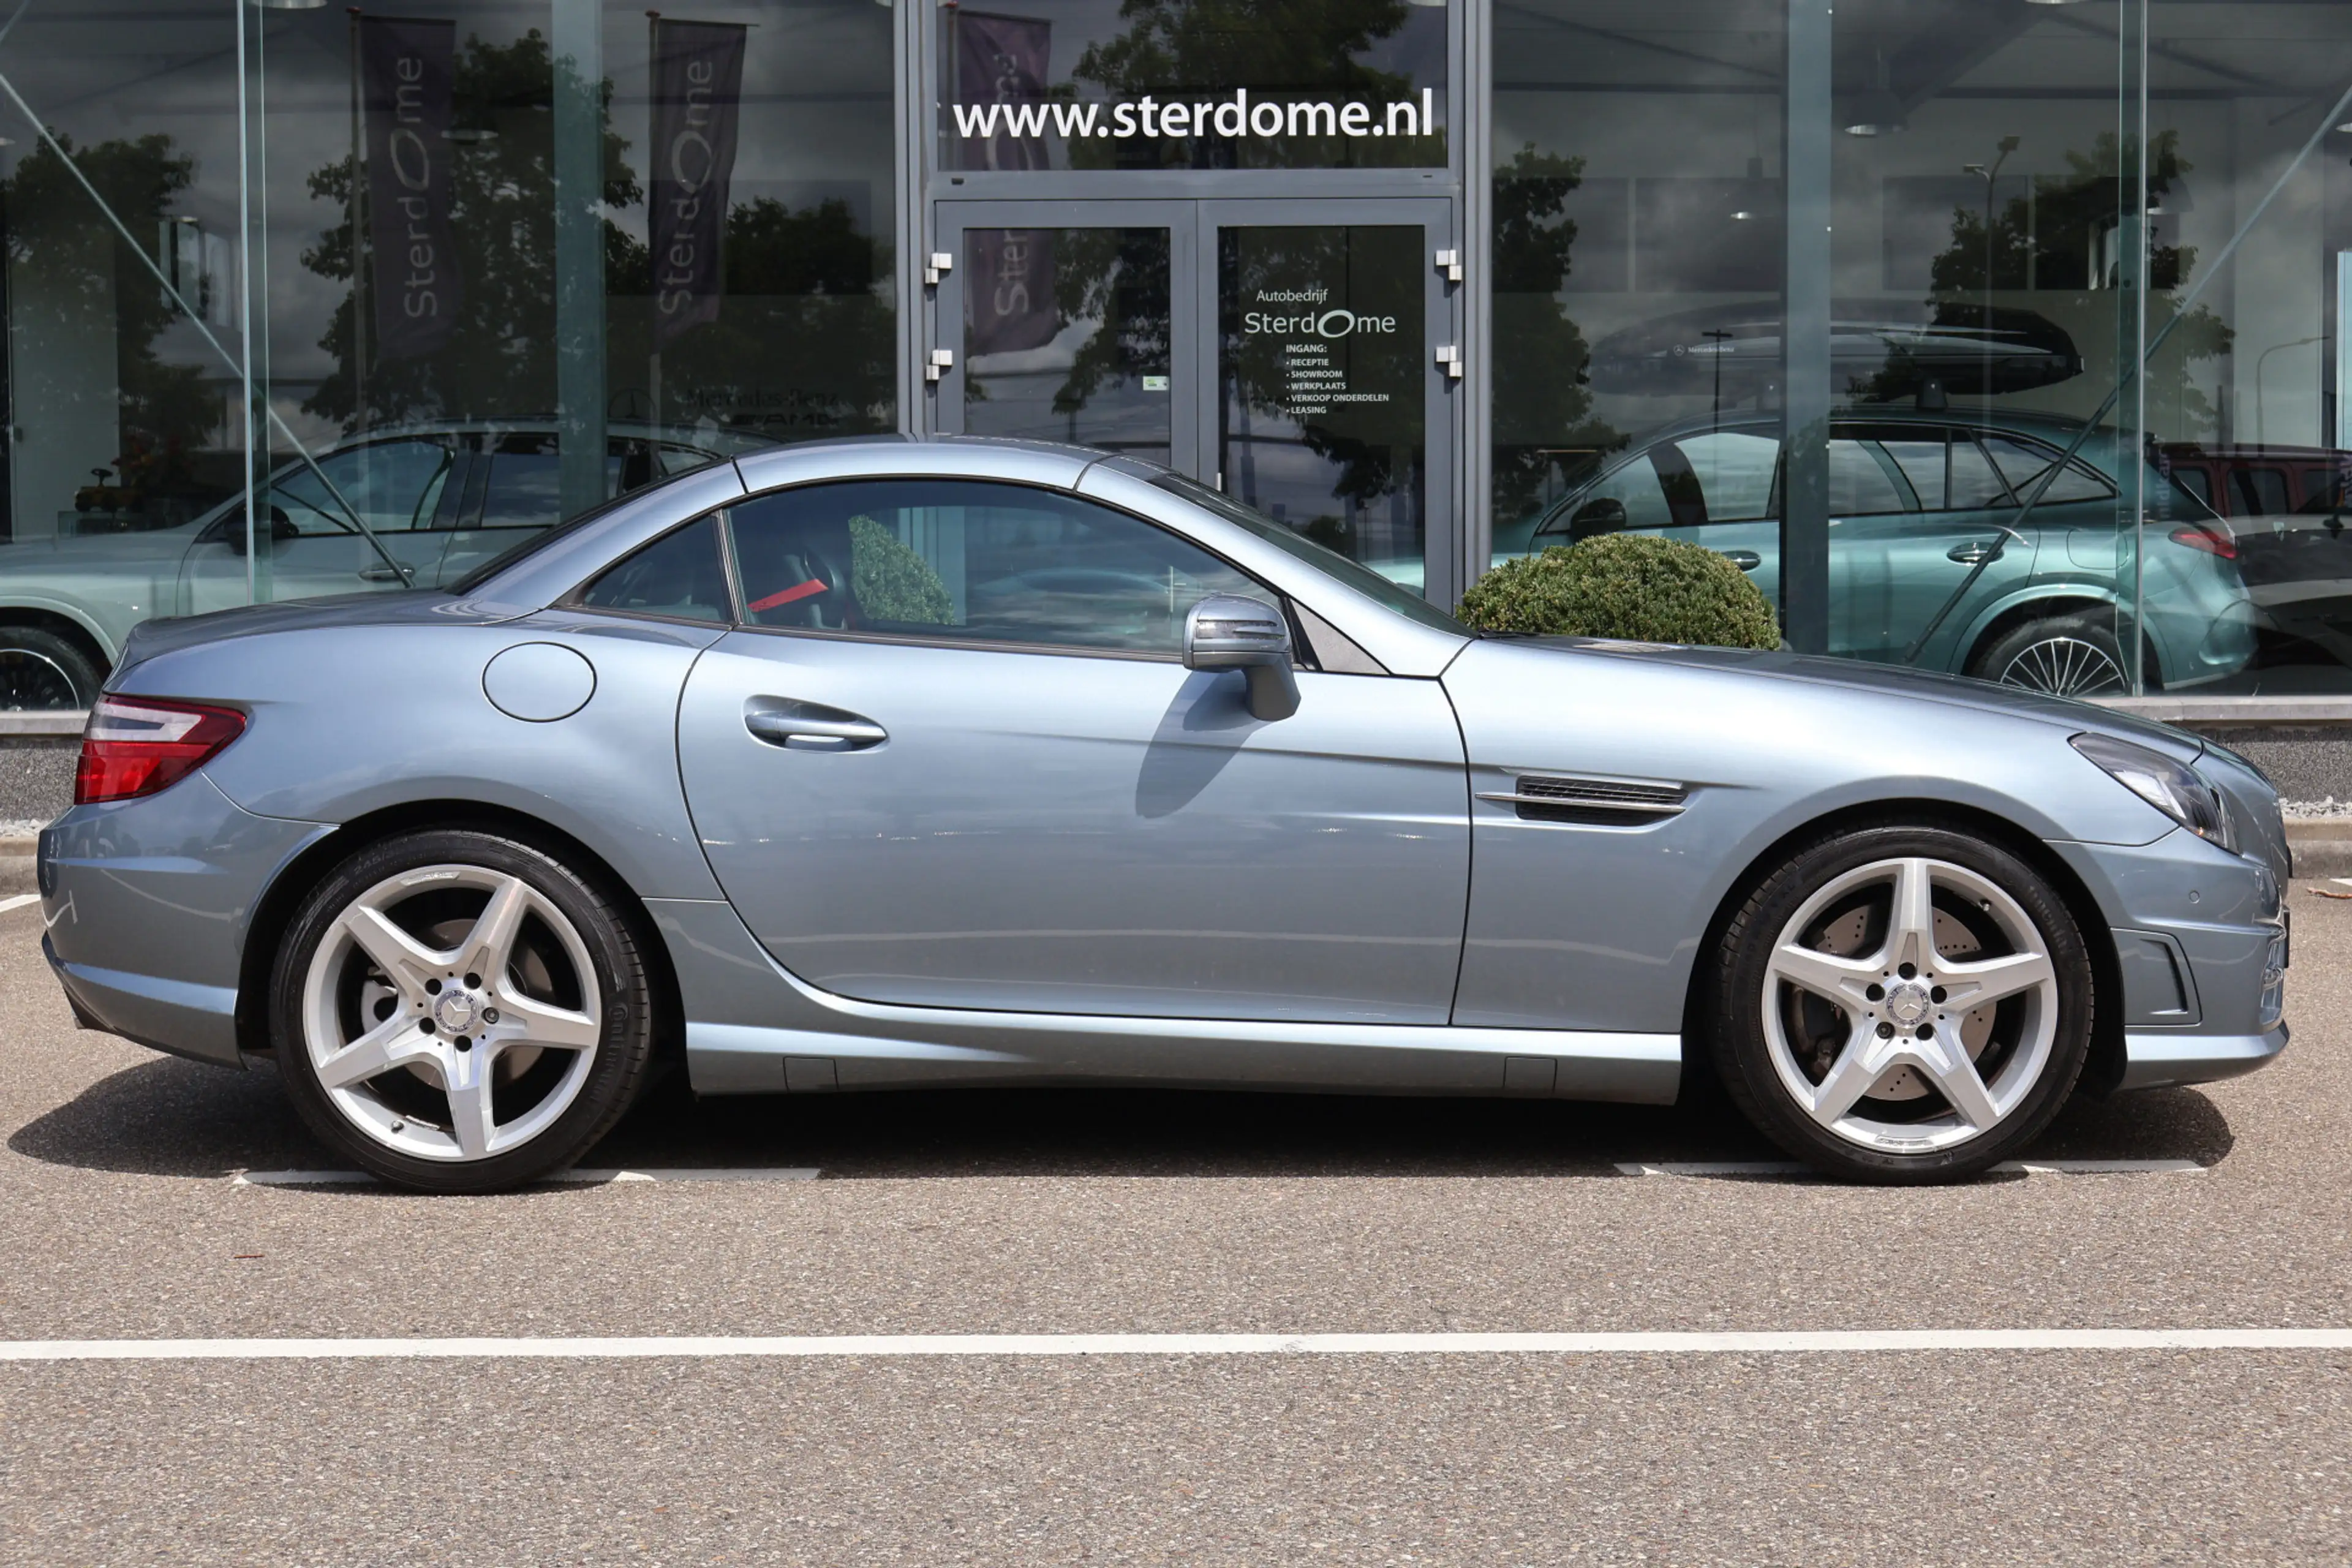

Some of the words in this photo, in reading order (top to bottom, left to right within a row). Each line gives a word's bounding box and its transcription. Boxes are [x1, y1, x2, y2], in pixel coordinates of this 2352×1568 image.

[953, 88, 1433, 138] www.sterdome.nl
[1256, 288, 1329, 304] Autobedrijf
[1286, 344, 1327, 353] INGANG:
